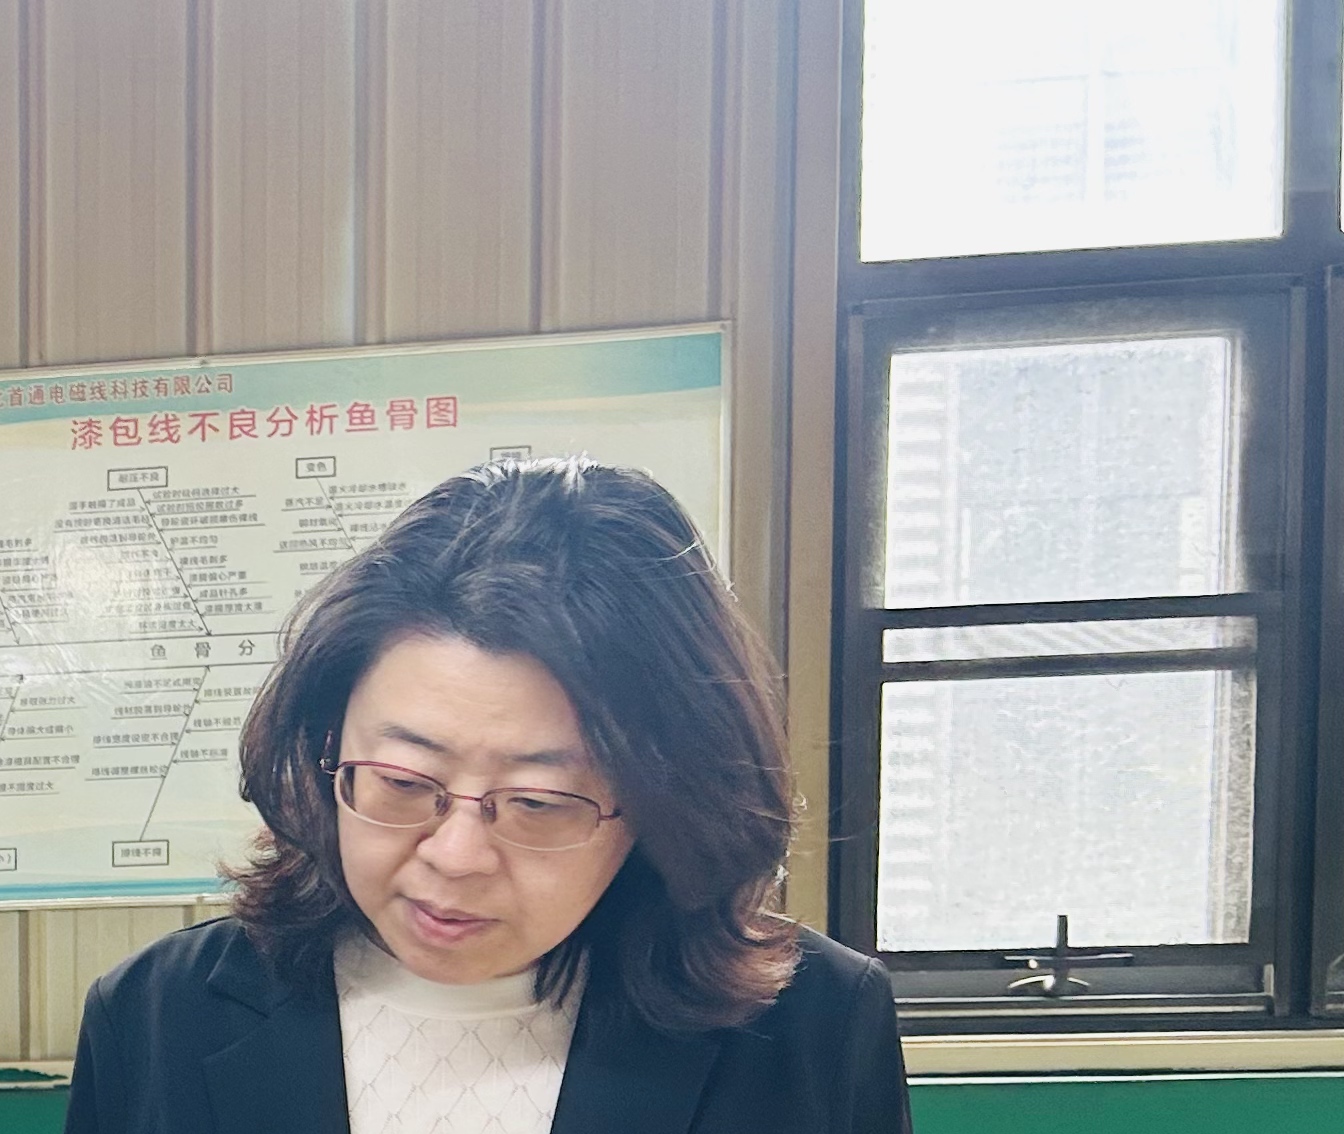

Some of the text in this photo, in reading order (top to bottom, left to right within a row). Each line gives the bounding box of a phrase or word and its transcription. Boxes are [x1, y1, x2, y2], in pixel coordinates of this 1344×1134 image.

[71, 395, 460, 452] 漆包线不良分析鱼骨图
